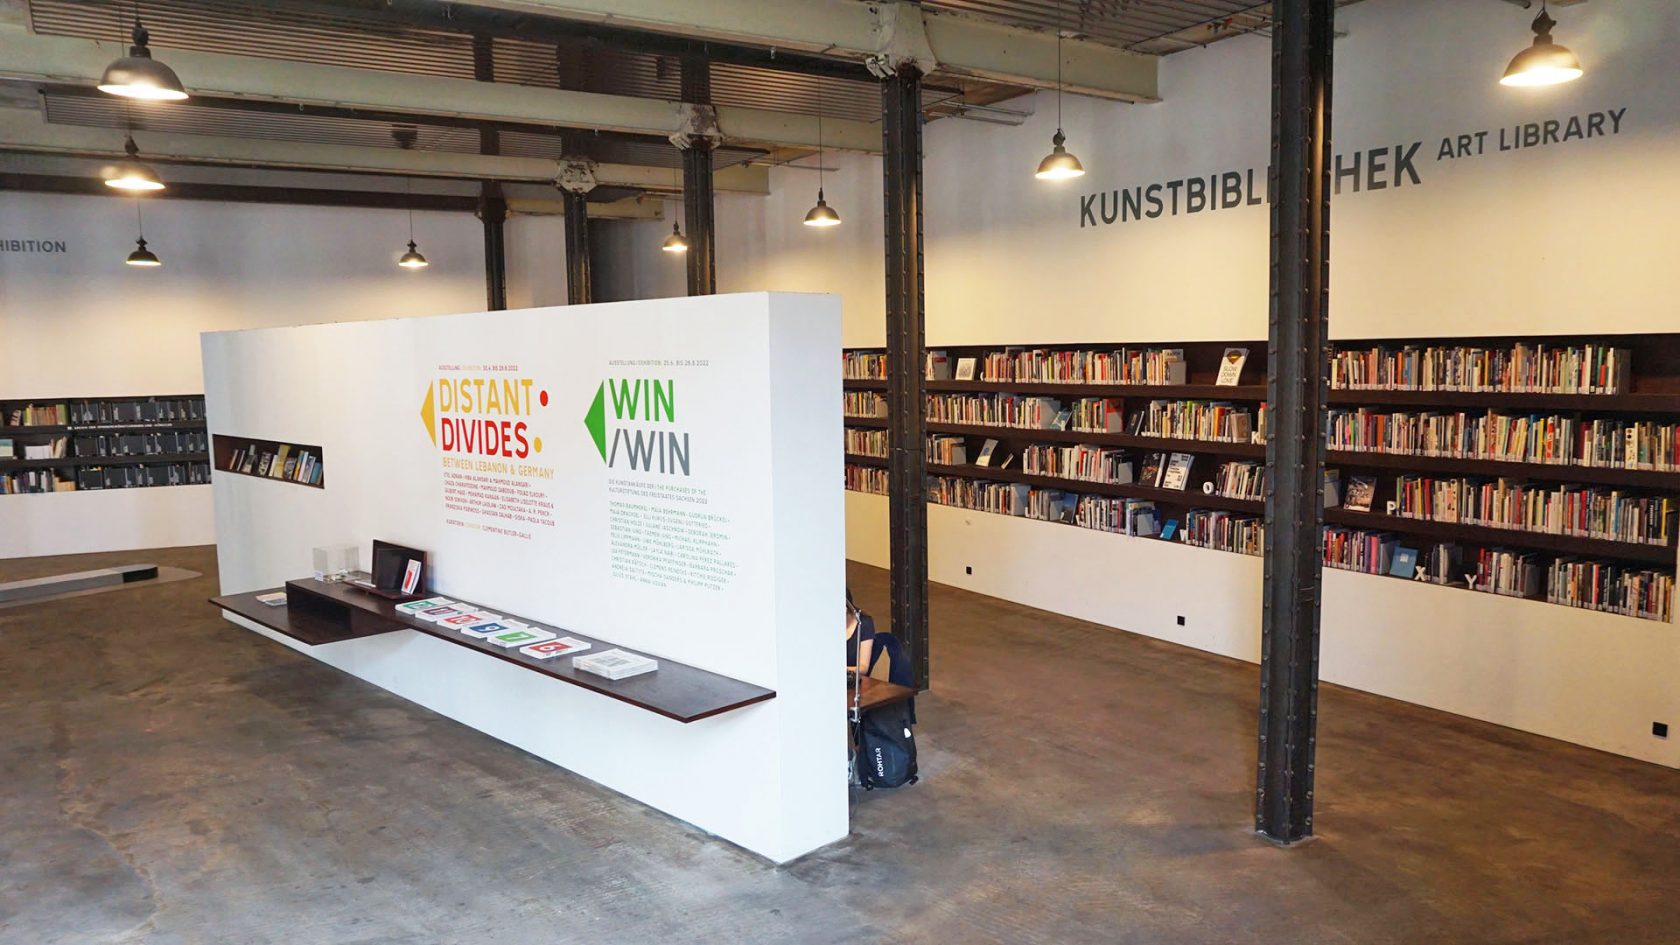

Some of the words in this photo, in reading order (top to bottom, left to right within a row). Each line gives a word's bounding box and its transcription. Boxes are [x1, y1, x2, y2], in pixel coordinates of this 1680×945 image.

[1080, 141, 1422, 228] KUNSTBIBLIHEK
[1437, 131, 1488, 160] ART
[1500, 107, 1626, 151] LIBRARY
[439, 378, 533, 416] DISTANT
[608, 378, 675, 423] WIN
[442, 417, 530, 459] DIVIDES
[608, 428, 690, 477] /WIN
[442, 457, 473, 470] BETWEEN
[475, 460, 507, 473] LEBANON
[510, 464, 516, 475] &
[518, 465, 555, 479] GERMANY
[1386, 501, 1396, 515] P
[1414, 566, 1426, 581] X
[1464, 574, 1477, 589] Y
[875, 747, 884, 777] ROHTAR
